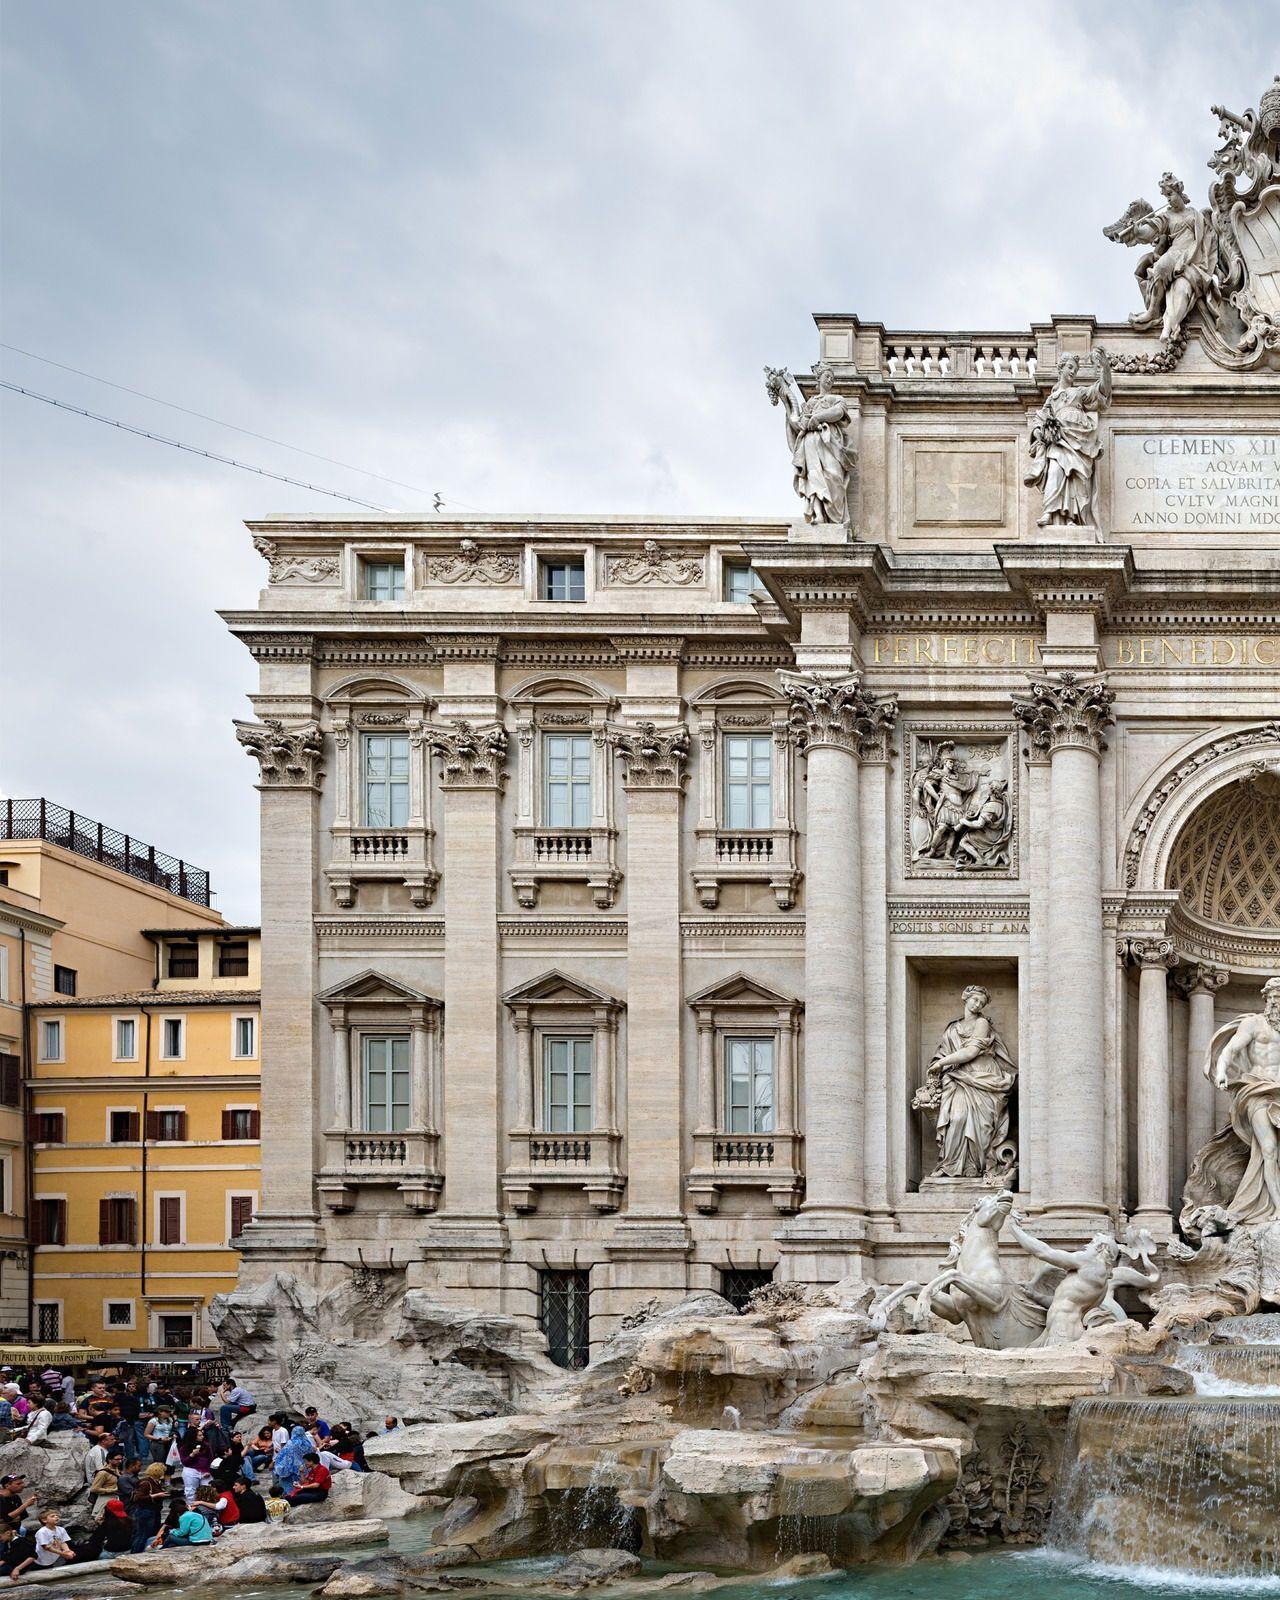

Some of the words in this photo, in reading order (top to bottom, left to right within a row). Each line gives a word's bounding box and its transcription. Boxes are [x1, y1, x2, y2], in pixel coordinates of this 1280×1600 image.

[1143, 439, 1235, 455] CLEMENS
[1205, 461, 1263, 476] AQVAM
[1126, 478, 1172, 490] COPIA
[1178, 478, 1196, 490] ET
[1165, 495, 1216, 507] CVLTV
[1131, 512, 1179, 525] ANNO
[1184, 512, 1242, 525] DOMINI
[873, 637, 1042, 664] PERFECIT
[893, 922, 932, 933] POSITIS
[939, 922, 973, 933] SIGNIS
[981, 922, 993, 933] ET
[2, 1354, 27, 1362] FRUTTA
